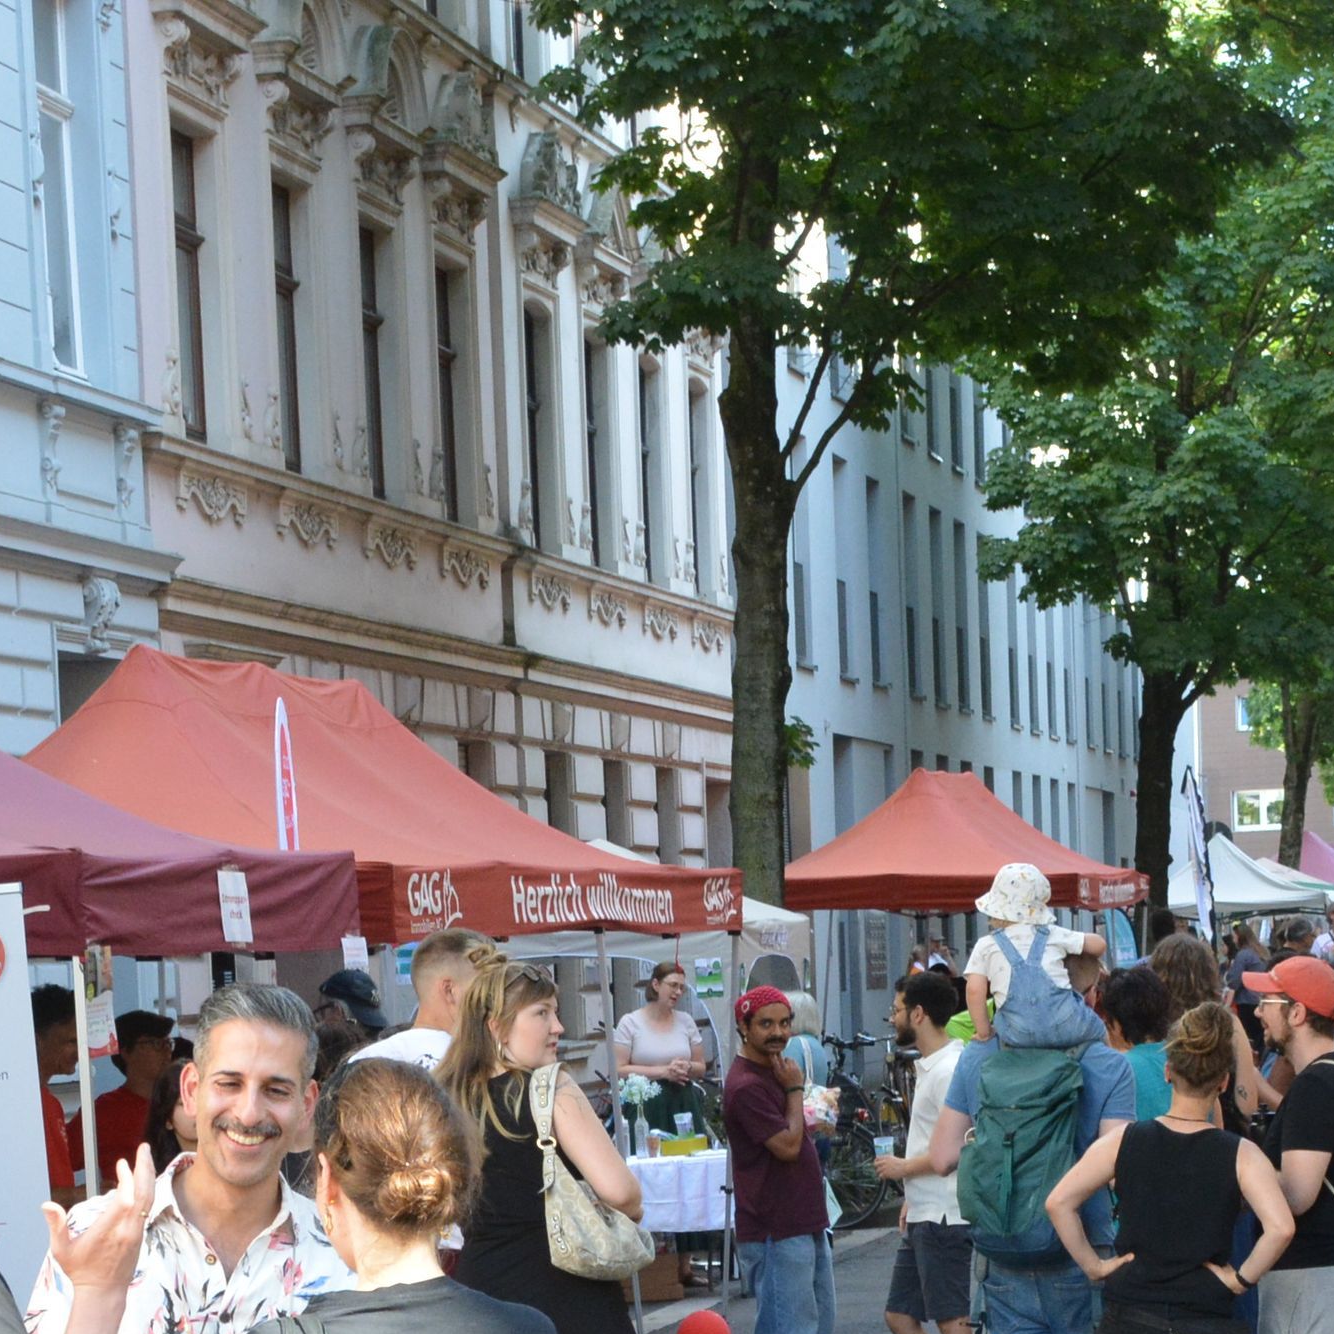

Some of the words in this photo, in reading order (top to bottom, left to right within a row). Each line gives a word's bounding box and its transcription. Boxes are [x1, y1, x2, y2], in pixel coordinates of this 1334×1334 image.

[407, 872, 441, 917] GAG
[510, 873, 587, 925] Herzlich
[585, 872, 675, 924] willkommen
[702, 876, 727, 912] GAG
